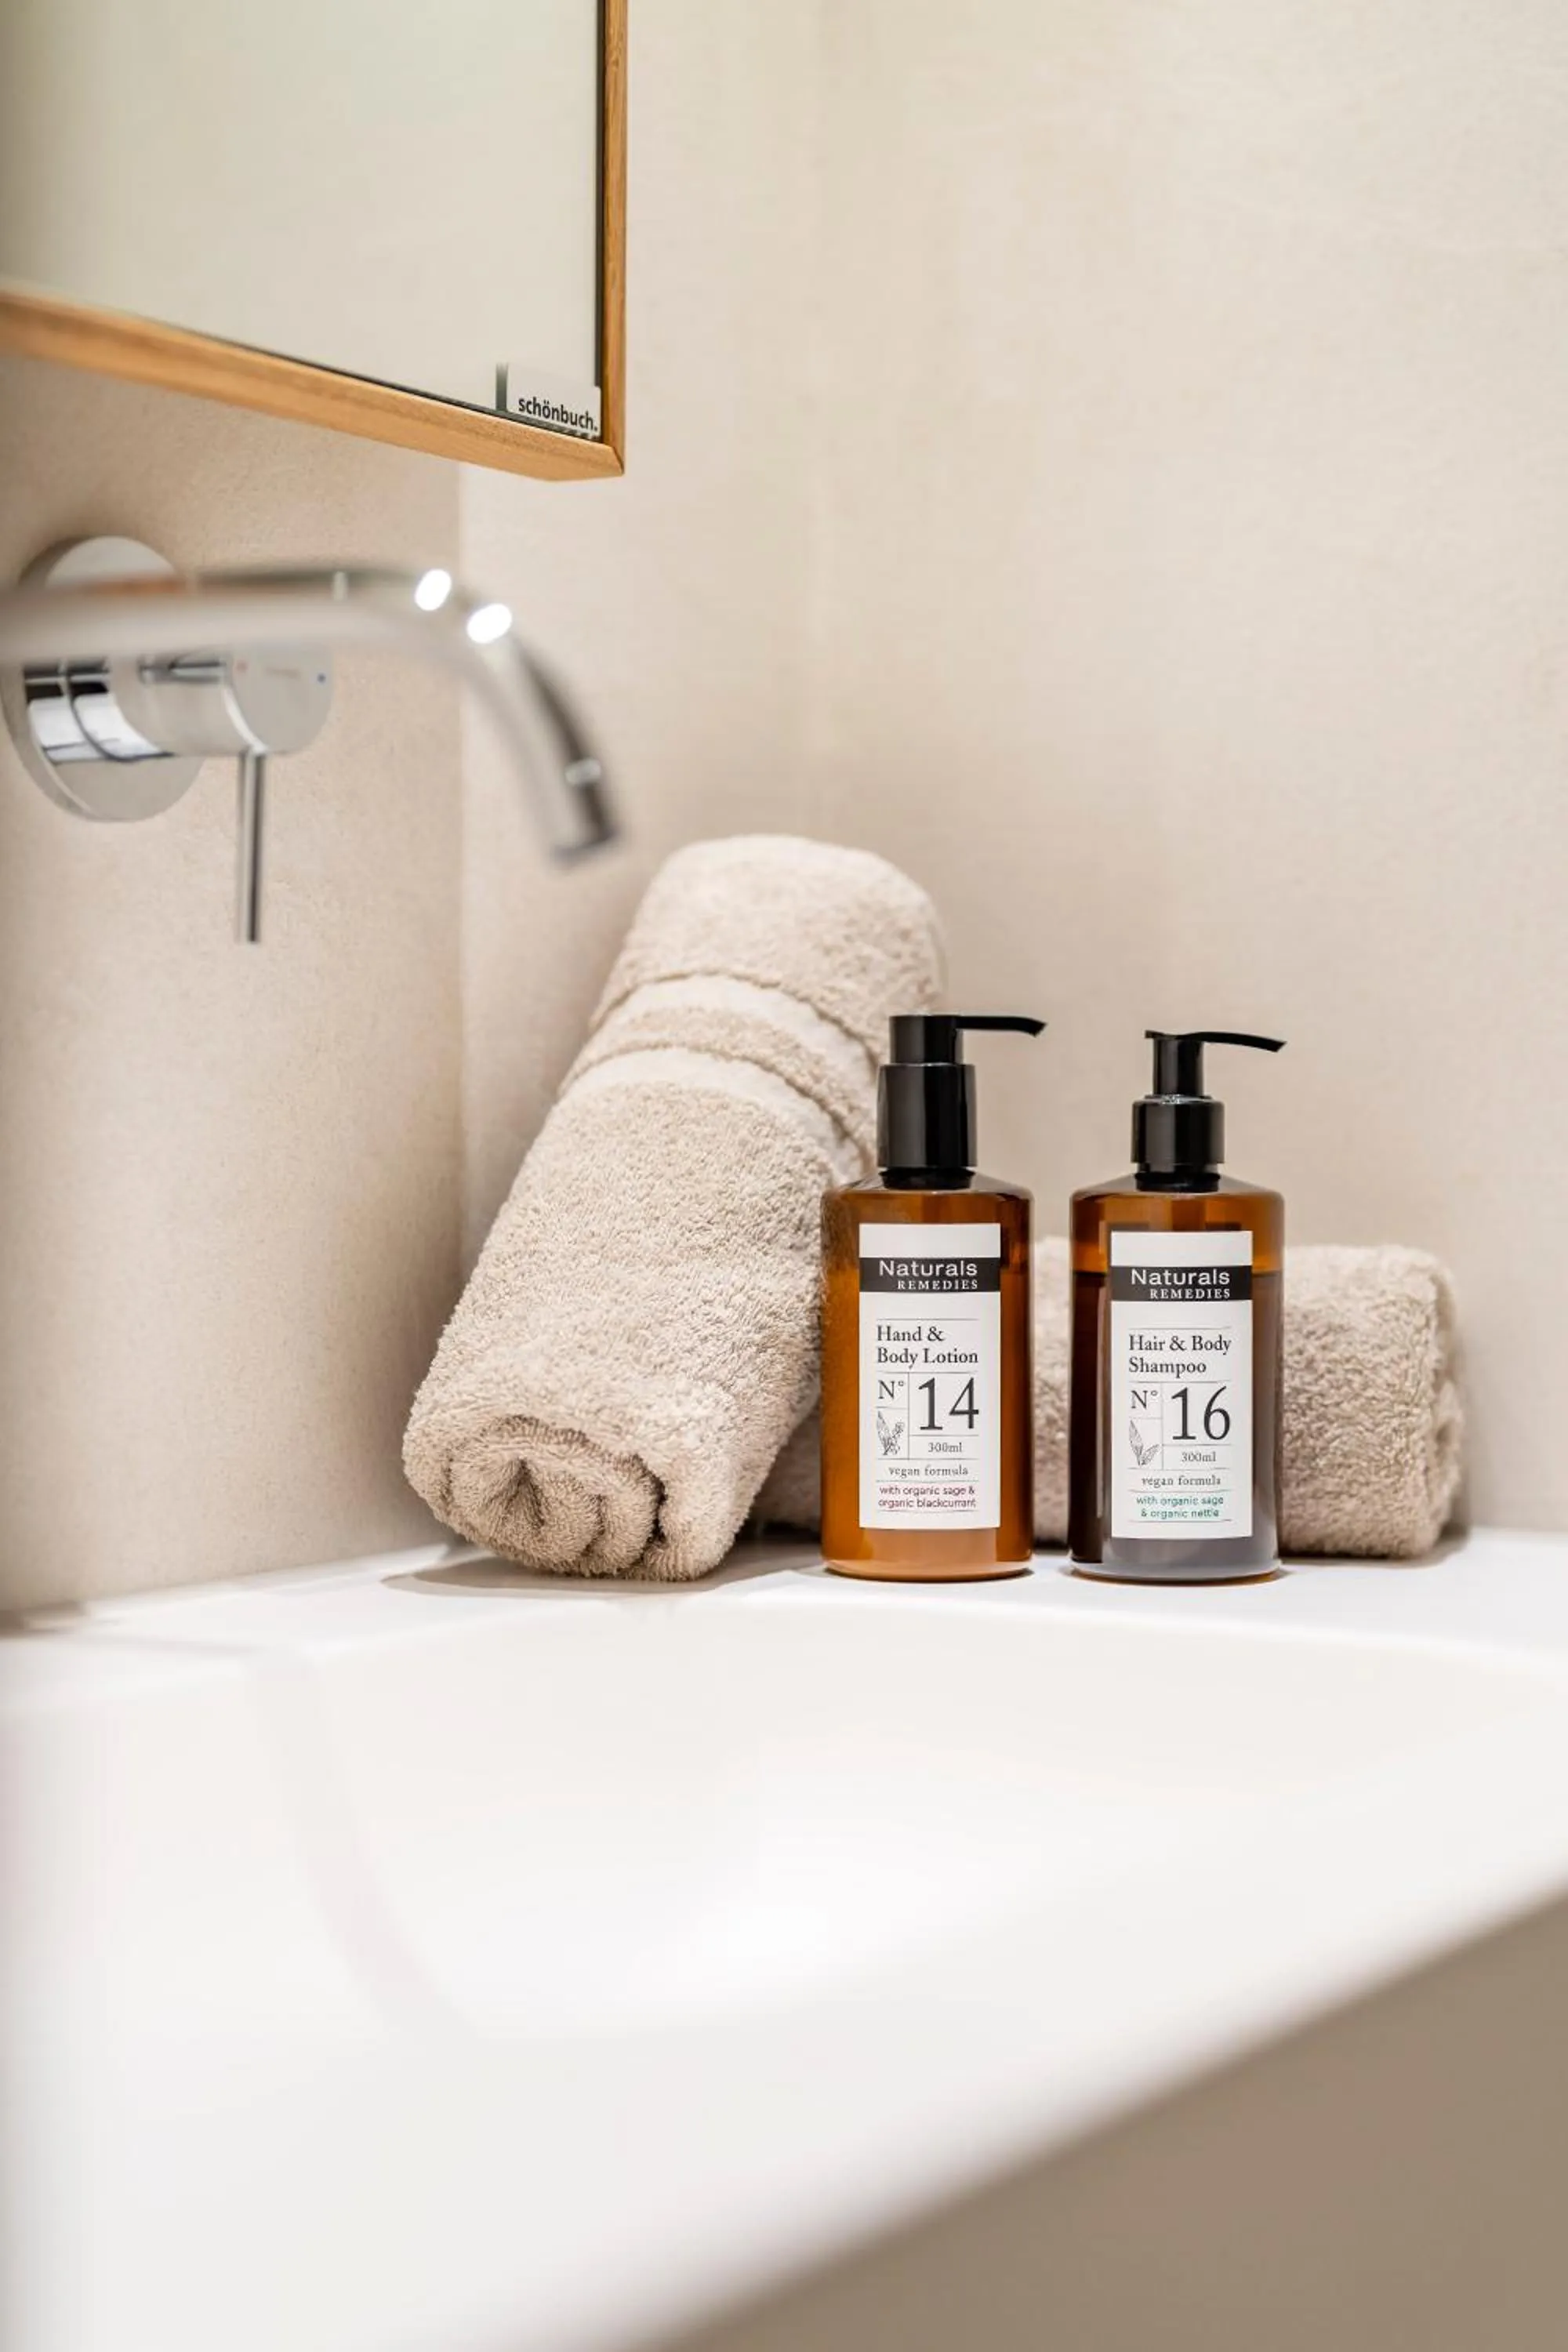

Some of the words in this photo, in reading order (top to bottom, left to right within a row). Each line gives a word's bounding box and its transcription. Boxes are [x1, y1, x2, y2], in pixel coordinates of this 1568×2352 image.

[518, 396, 598, 431] schönbuch.
[878, 1260, 978, 1277] Naturals
[897, 1279, 978, 1290] REMEDIES
[1131, 1269, 1230, 1286] Naturals
[1150, 1288, 1230, 1298] REMEDIES
[877, 1325, 922, 1341] Hand
[927, 1326, 944, 1341] &
[1129, 1334, 1166, 1351] Hair
[1169, 1335, 1185, 1352] &
[1192, 1334, 1232, 1355] Body
[877, 1348, 919, 1369] Body
[923, 1348, 978, 1363] Lotion
[1129, 1357, 1207, 1378] Shampoo
[918, 1377, 979, 1431] 14
[1171, 1385, 1230, 1441] 16
[927, 1442, 962, 1453] 300ml
[1181, 1451, 1216, 1462] 300ml
[888, 1467, 920, 1479] vegan
[924, 1465, 968, 1476] formula
[1142, 1477, 1174, 1488] vegan
[1178, 1475, 1221, 1486] formula
[880, 1486, 901, 1495] with
[903, 1486, 941, 1498] organic
[942, 1487, 967, 1497] sage
[878, 1498, 914, 1510] organic
[916, 1498, 975, 1508] blackcurrant
[1137, 1496, 1158, 1505] with
[1160, 1496, 1199, 1508] organic
[1201, 1497, 1224, 1507] sage
[1141, 1509, 1147, 1518] &
[1151, 1509, 1189, 1521] organic
[1191, 1508, 1219, 1518] nettle
